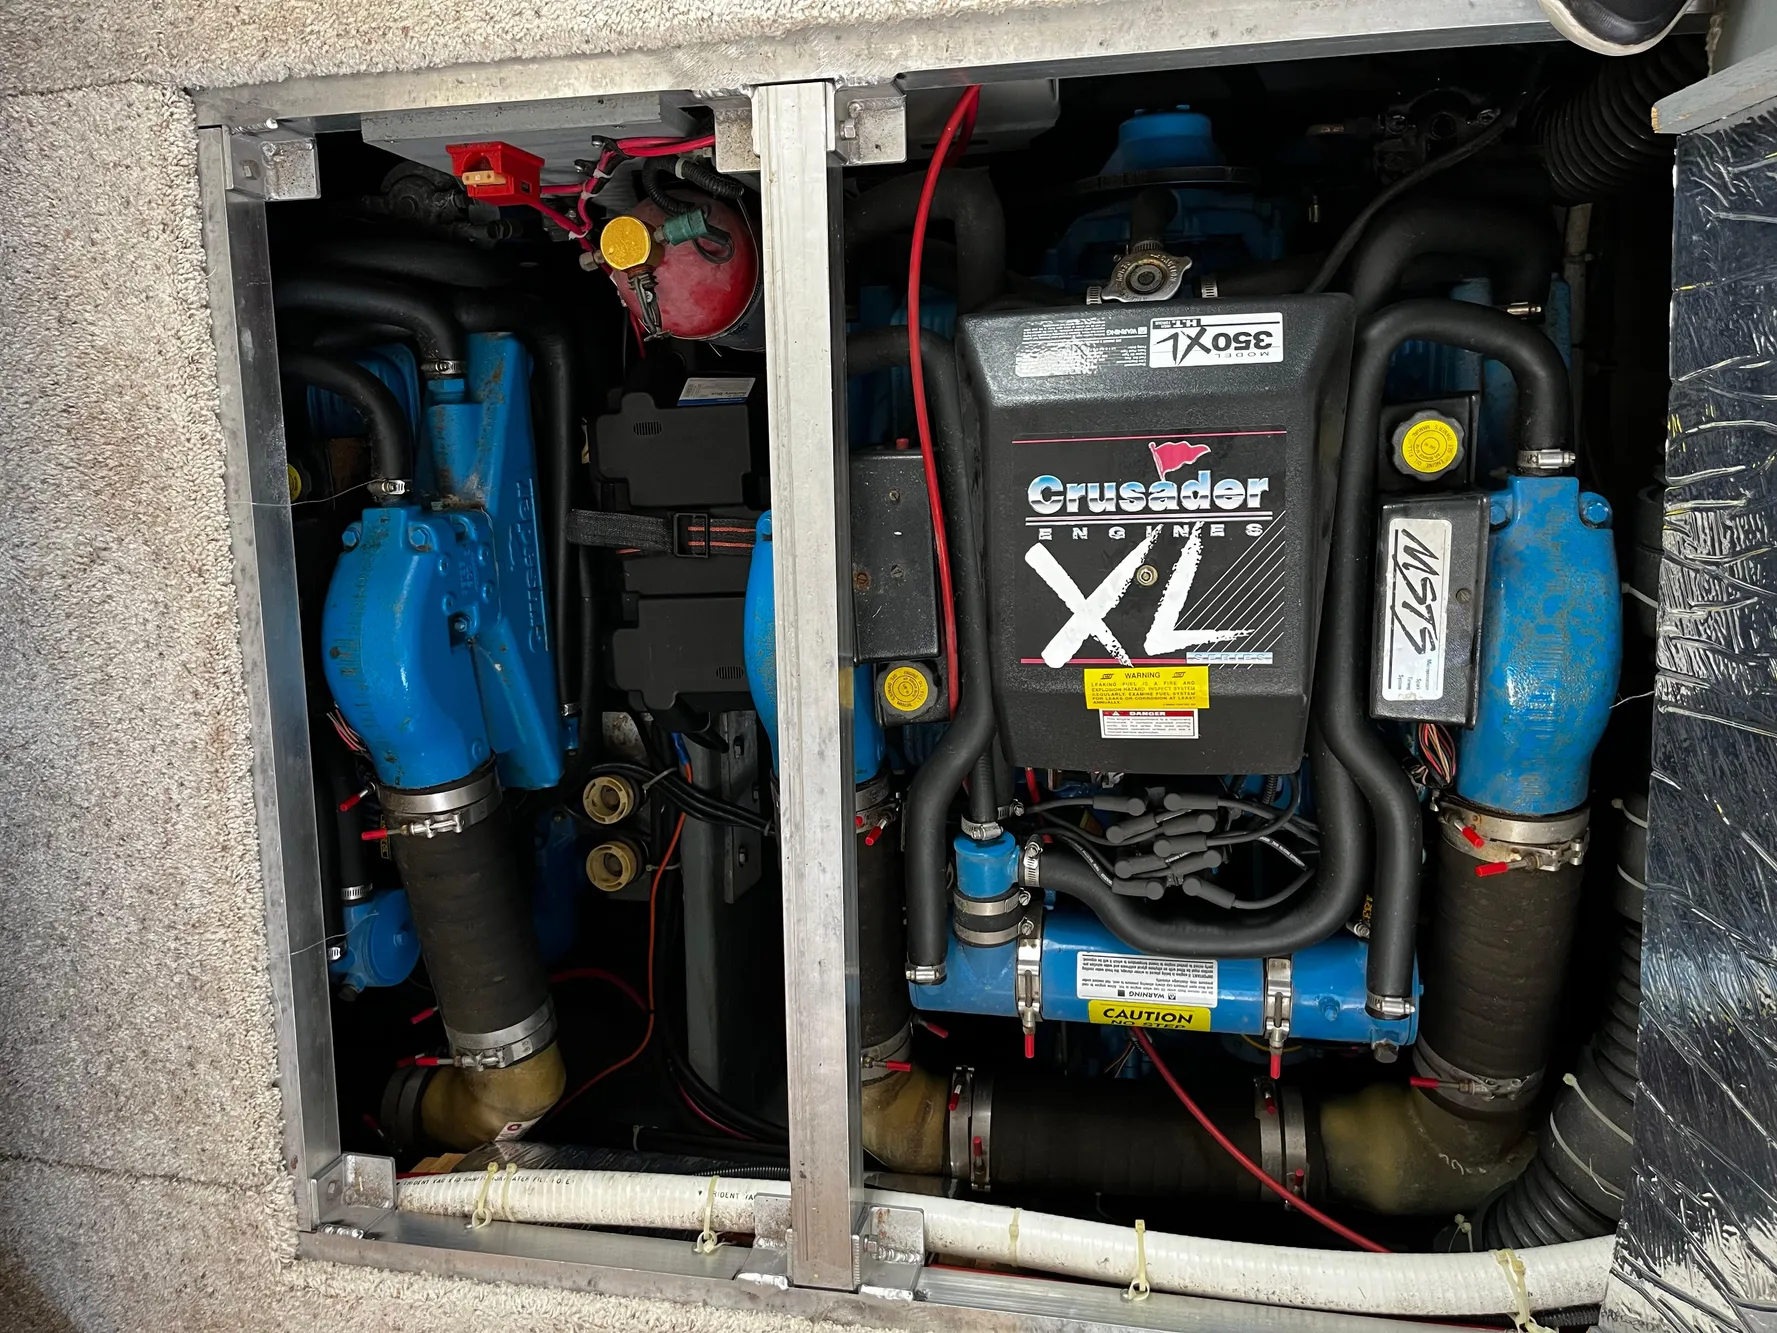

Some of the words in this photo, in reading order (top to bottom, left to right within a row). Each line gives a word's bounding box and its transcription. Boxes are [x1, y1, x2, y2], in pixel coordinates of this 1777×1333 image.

[1106, 328, 1137, 336] WARNING
[1215, 351, 1269, 359] MODEL
[1027, 470, 1268, 514] Crusader
[1038, 523, 1264, 540] ENGINES
[1025, 520, 1255, 668] XL
[1390, 528, 1439, 655] MSTS
[1195, 653, 1264, 661] SERIES
[1129, 991, 1165, 999] WARNING
[1103, 1008, 1193, 1024] CAUTION
[713, 1191, 739, 1199] RIDENT
